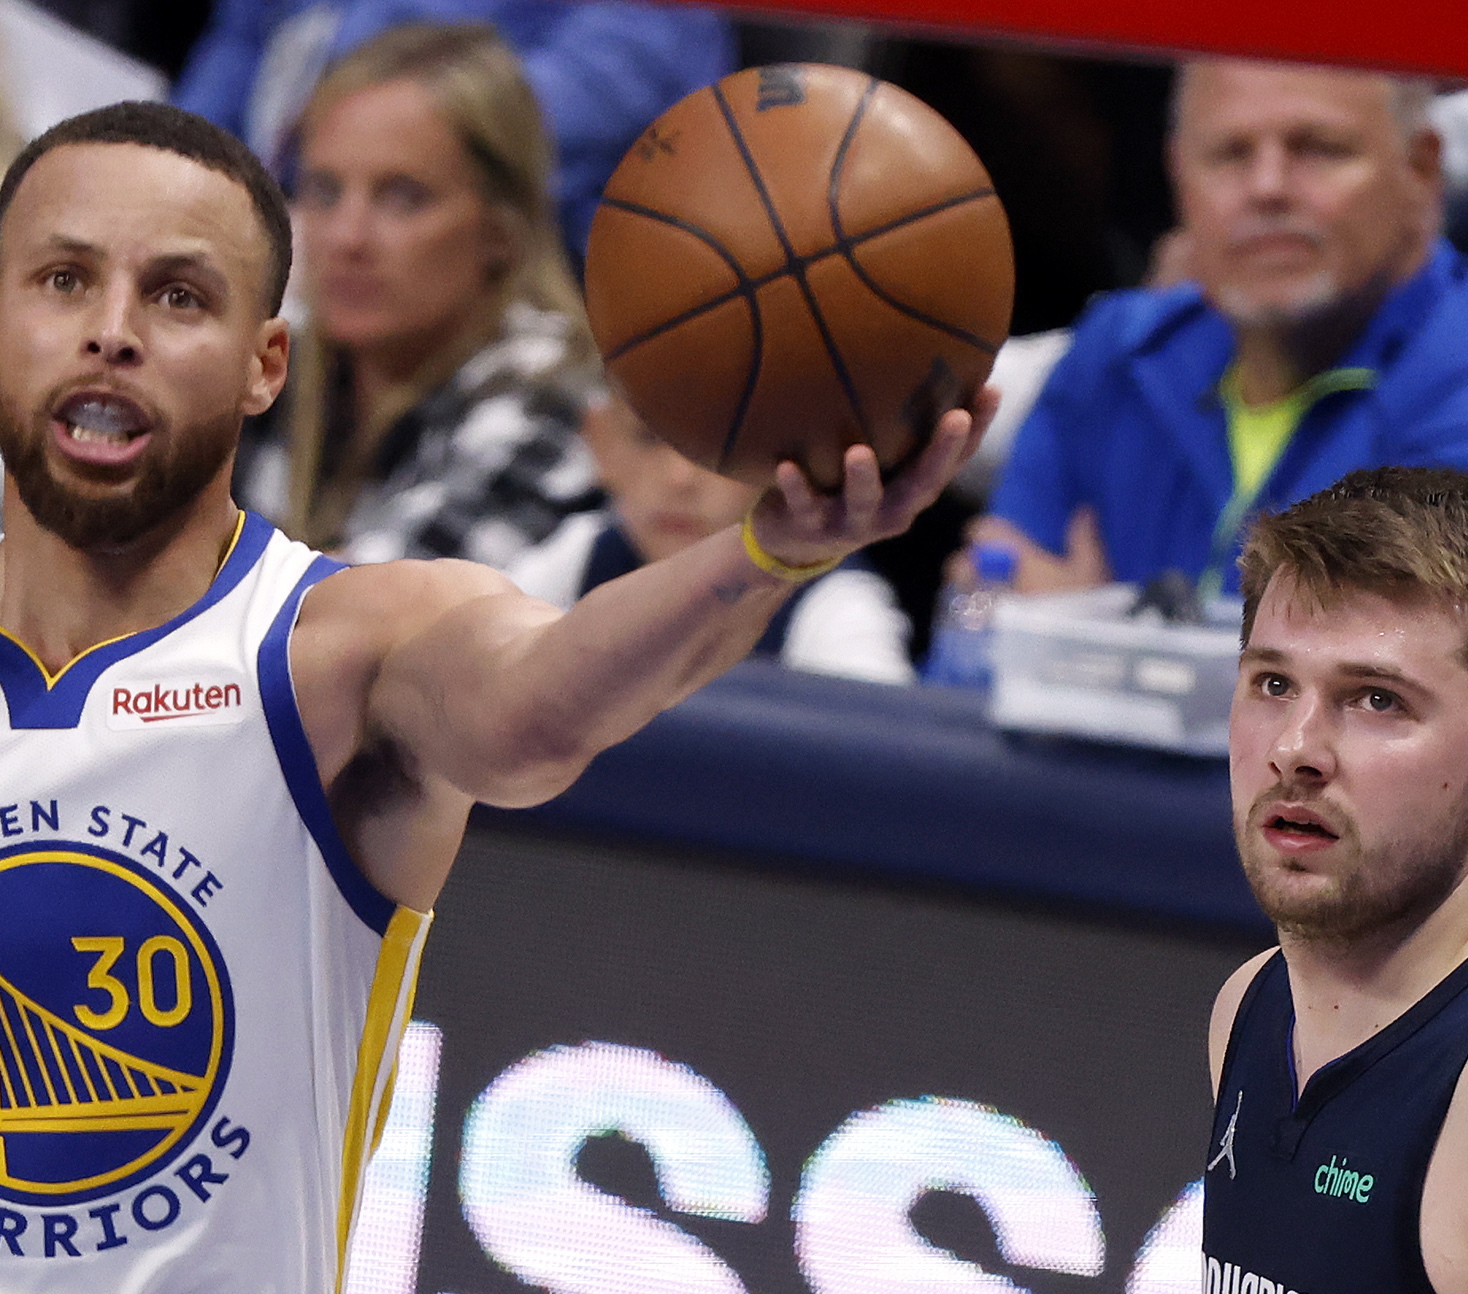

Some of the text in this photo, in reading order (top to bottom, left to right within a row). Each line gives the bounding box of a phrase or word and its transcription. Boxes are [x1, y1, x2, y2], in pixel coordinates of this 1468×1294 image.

[112, 682, 241, 717] Rakuten
[87, 804, 224, 908] STATE
[71, 936, 192, 1030] 30
[1314, 1155, 1374, 1203] chime
